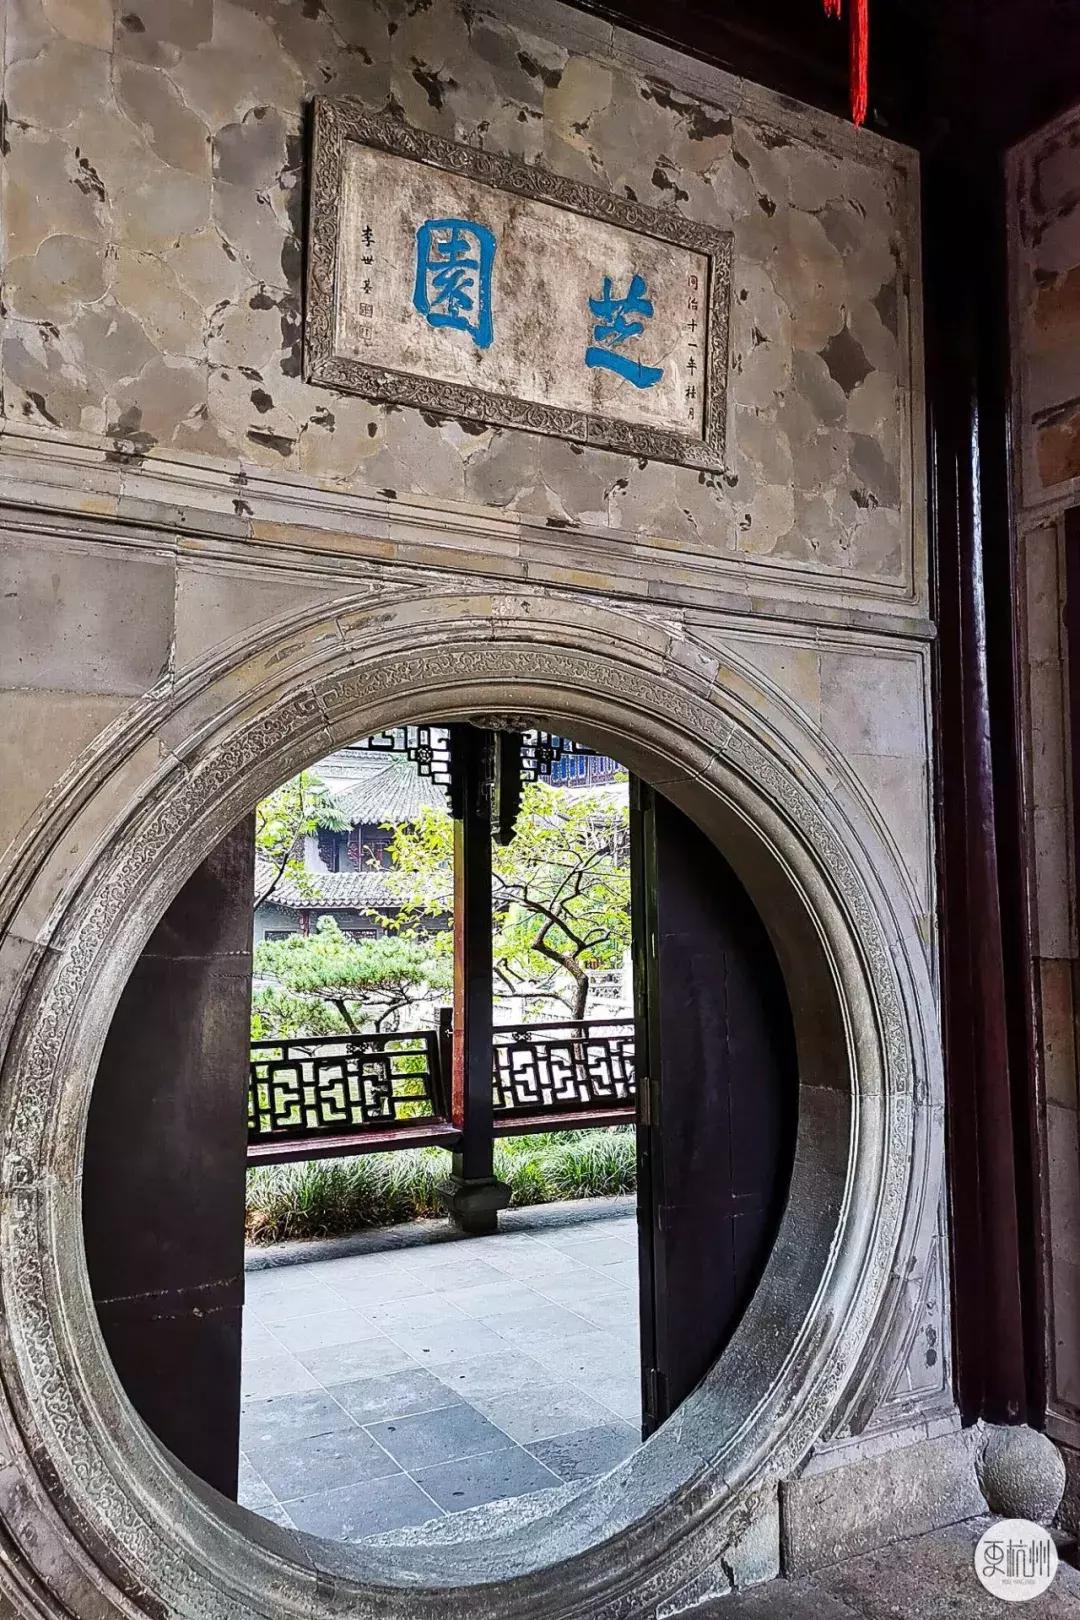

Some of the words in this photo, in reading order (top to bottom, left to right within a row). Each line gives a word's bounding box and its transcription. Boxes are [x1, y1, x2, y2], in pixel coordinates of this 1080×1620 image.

[685, 274, 699, 420] 同治十一年桂月
